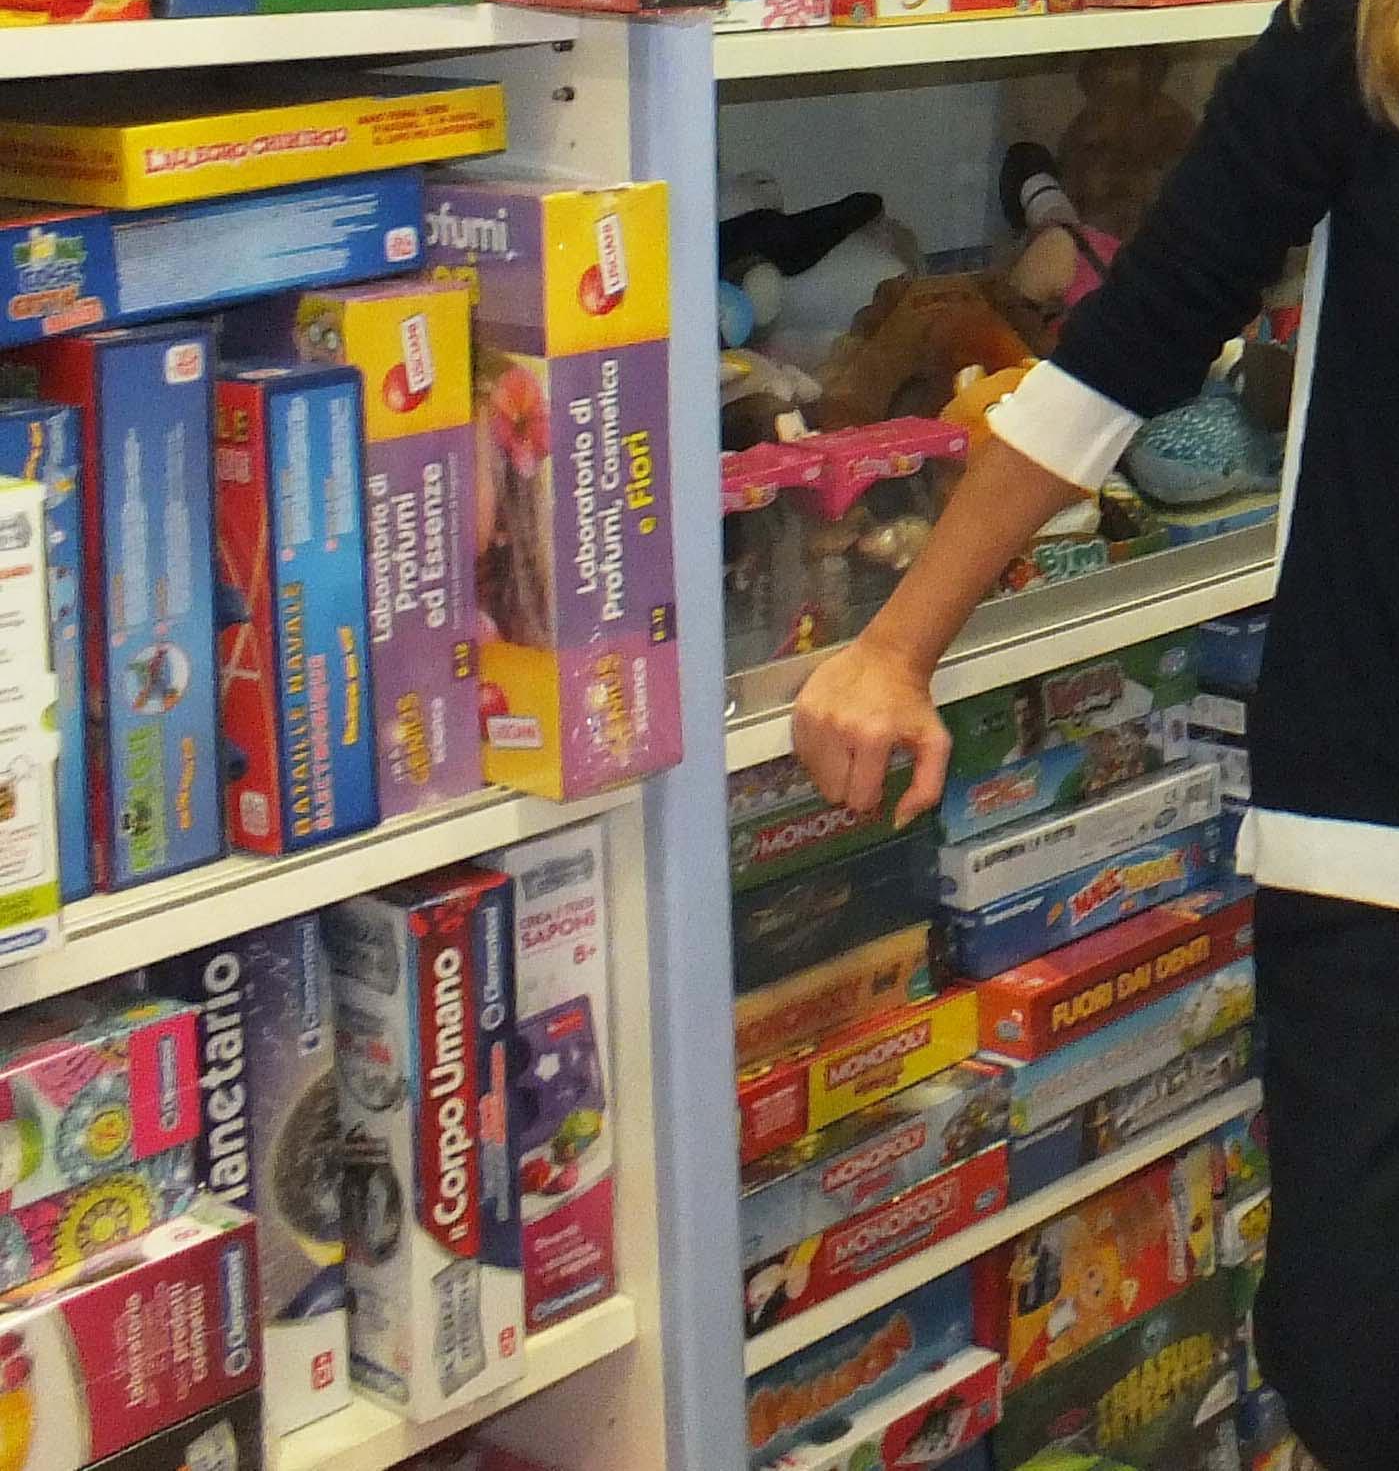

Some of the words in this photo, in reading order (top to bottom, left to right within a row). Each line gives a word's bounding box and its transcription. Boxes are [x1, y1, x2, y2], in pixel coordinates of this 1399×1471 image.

[427, 201, 518, 261] ofumi,
[569, 397, 595, 425] di
[597, 358, 621, 492] Cosmetica
[369, 472, 388, 498] di
[620, 429, 655, 511] Fiori
[391, 490, 418, 613] Profumi
[421, 462, 446, 583] Essenze
[569, 433, 597, 596] Laboratorio
[640, 516, 657, 535] e
[370, 501, 392, 643] Laboratorio
[596, 498, 625, 622] Profumi,
[421, 587, 447, 628] ed
[755, 807, 857, 860] MONOPO
[429, 946, 466, 1101] Umano
[829, 1023, 930, 1084] MONOPOLY
[199, 951, 250, 1206] lanetario
[433, 1097, 474, 1227] Corpo
[824, 1125, 926, 1192] MONOPOLY
[836, 1178, 952, 1260] MONOPOLY
